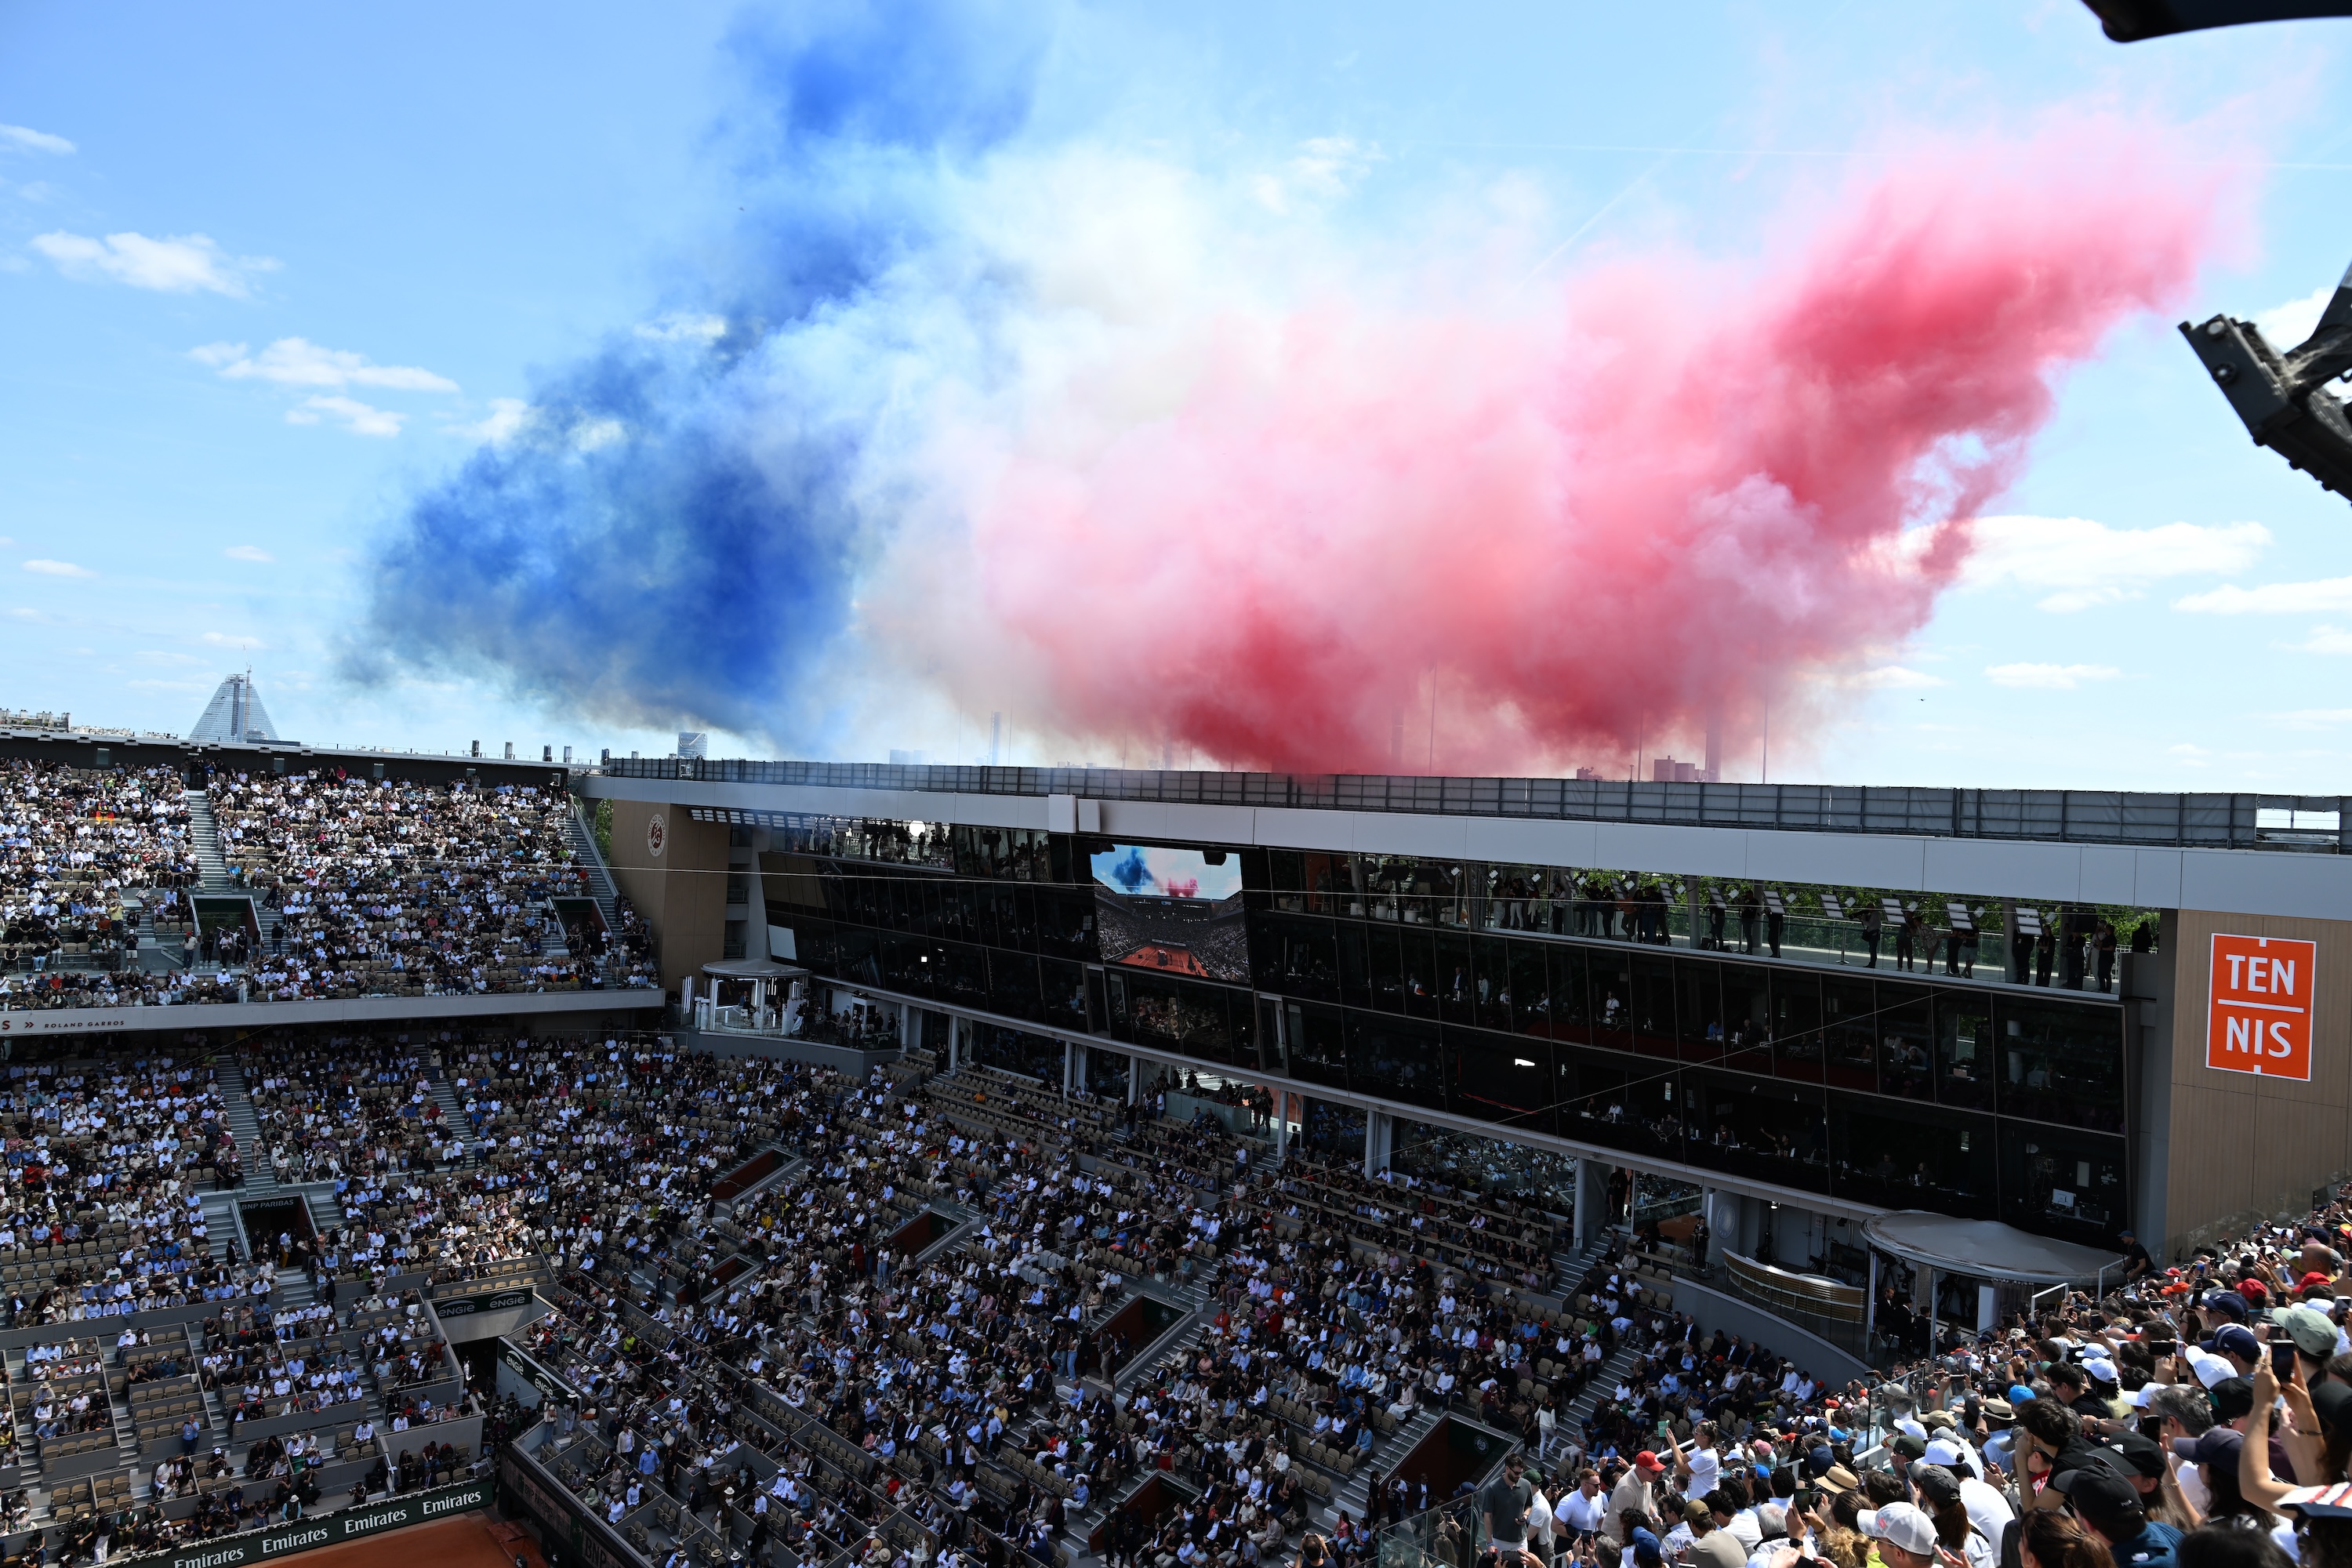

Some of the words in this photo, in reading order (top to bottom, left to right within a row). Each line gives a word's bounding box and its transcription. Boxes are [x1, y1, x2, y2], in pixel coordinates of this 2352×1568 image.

[2226, 954, 2296, 996] TEN
[2226, 1015, 2292, 1058] NIS
[260, 1199, 294, 1208] PARIBAS
[423, 1491, 482, 1515] Emirates
[344, 1508, 408, 1534] Emirates
[262, 1528, 328, 1554] Emirates
[586, 1535, 607, 1568] BNP
[174, 1548, 245, 1568] Emirates
